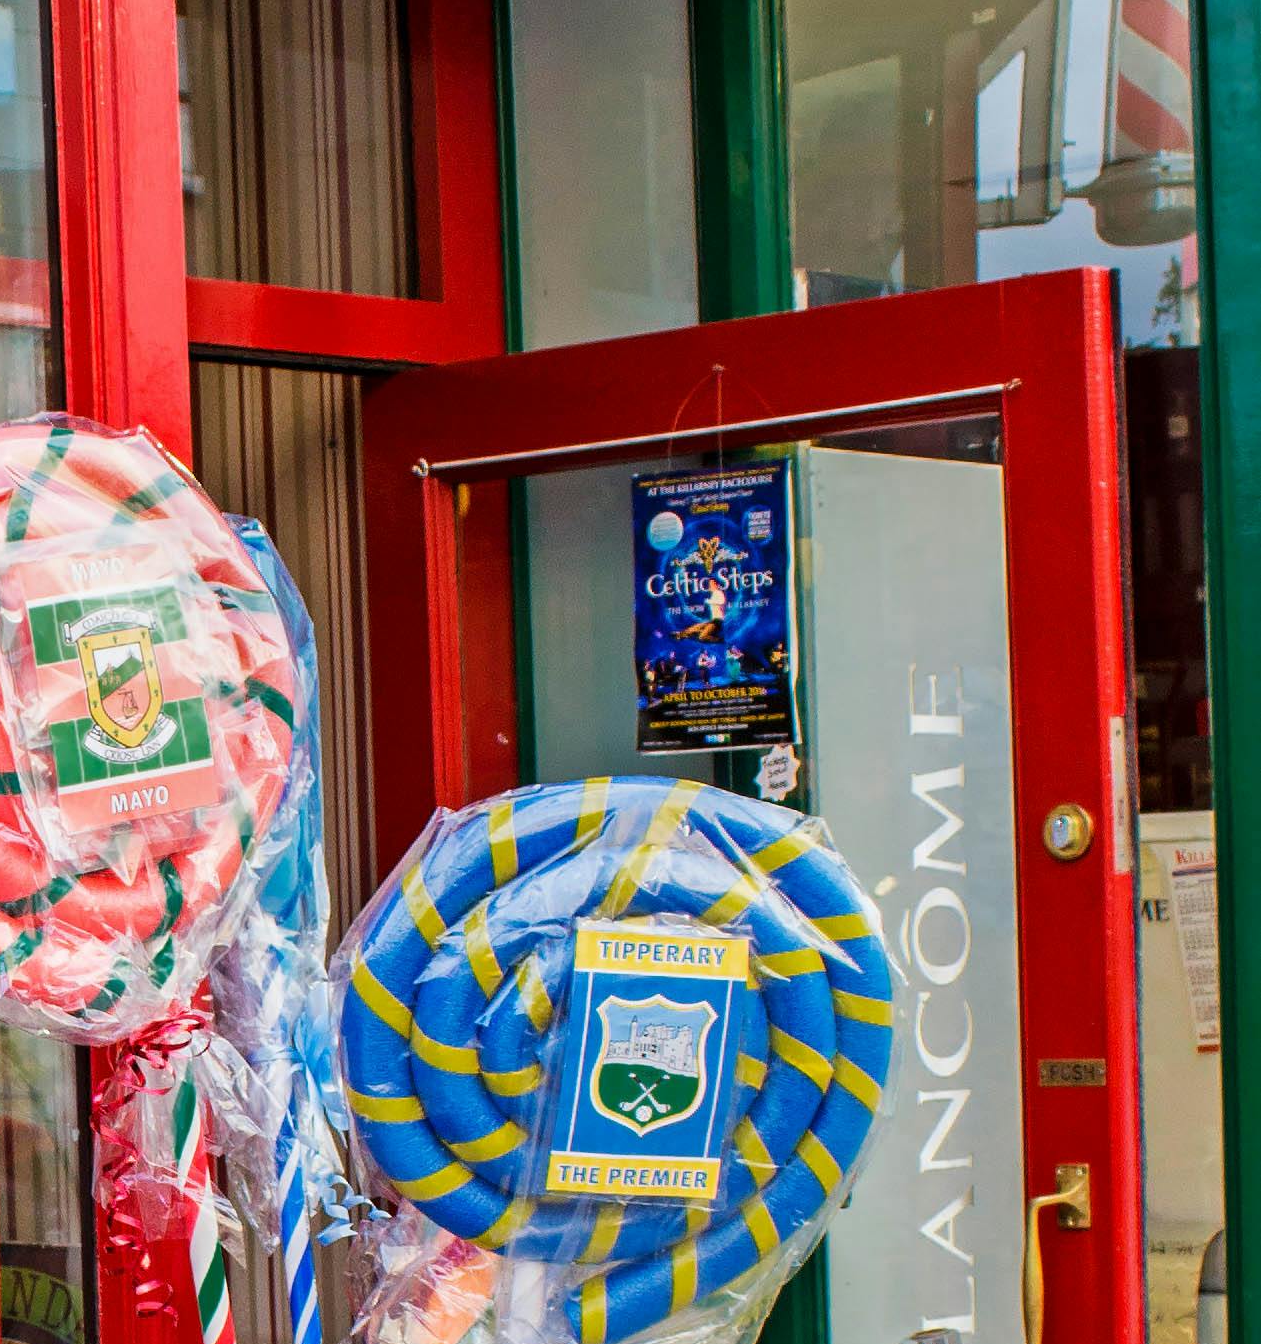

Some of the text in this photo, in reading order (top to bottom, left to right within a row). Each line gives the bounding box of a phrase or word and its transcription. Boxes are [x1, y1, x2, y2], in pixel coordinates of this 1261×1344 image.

[646, 566, 774, 598] Celtic Steps
[109, 784, 170, 815] MAYO
[599, 940, 727, 967] TIPPERARY
[899, 661, 978, 1337] LANCÔME
[1048, 1063, 1098, 1083] PUSH
[559, 1164, 709, 1189] THE PREMIER
